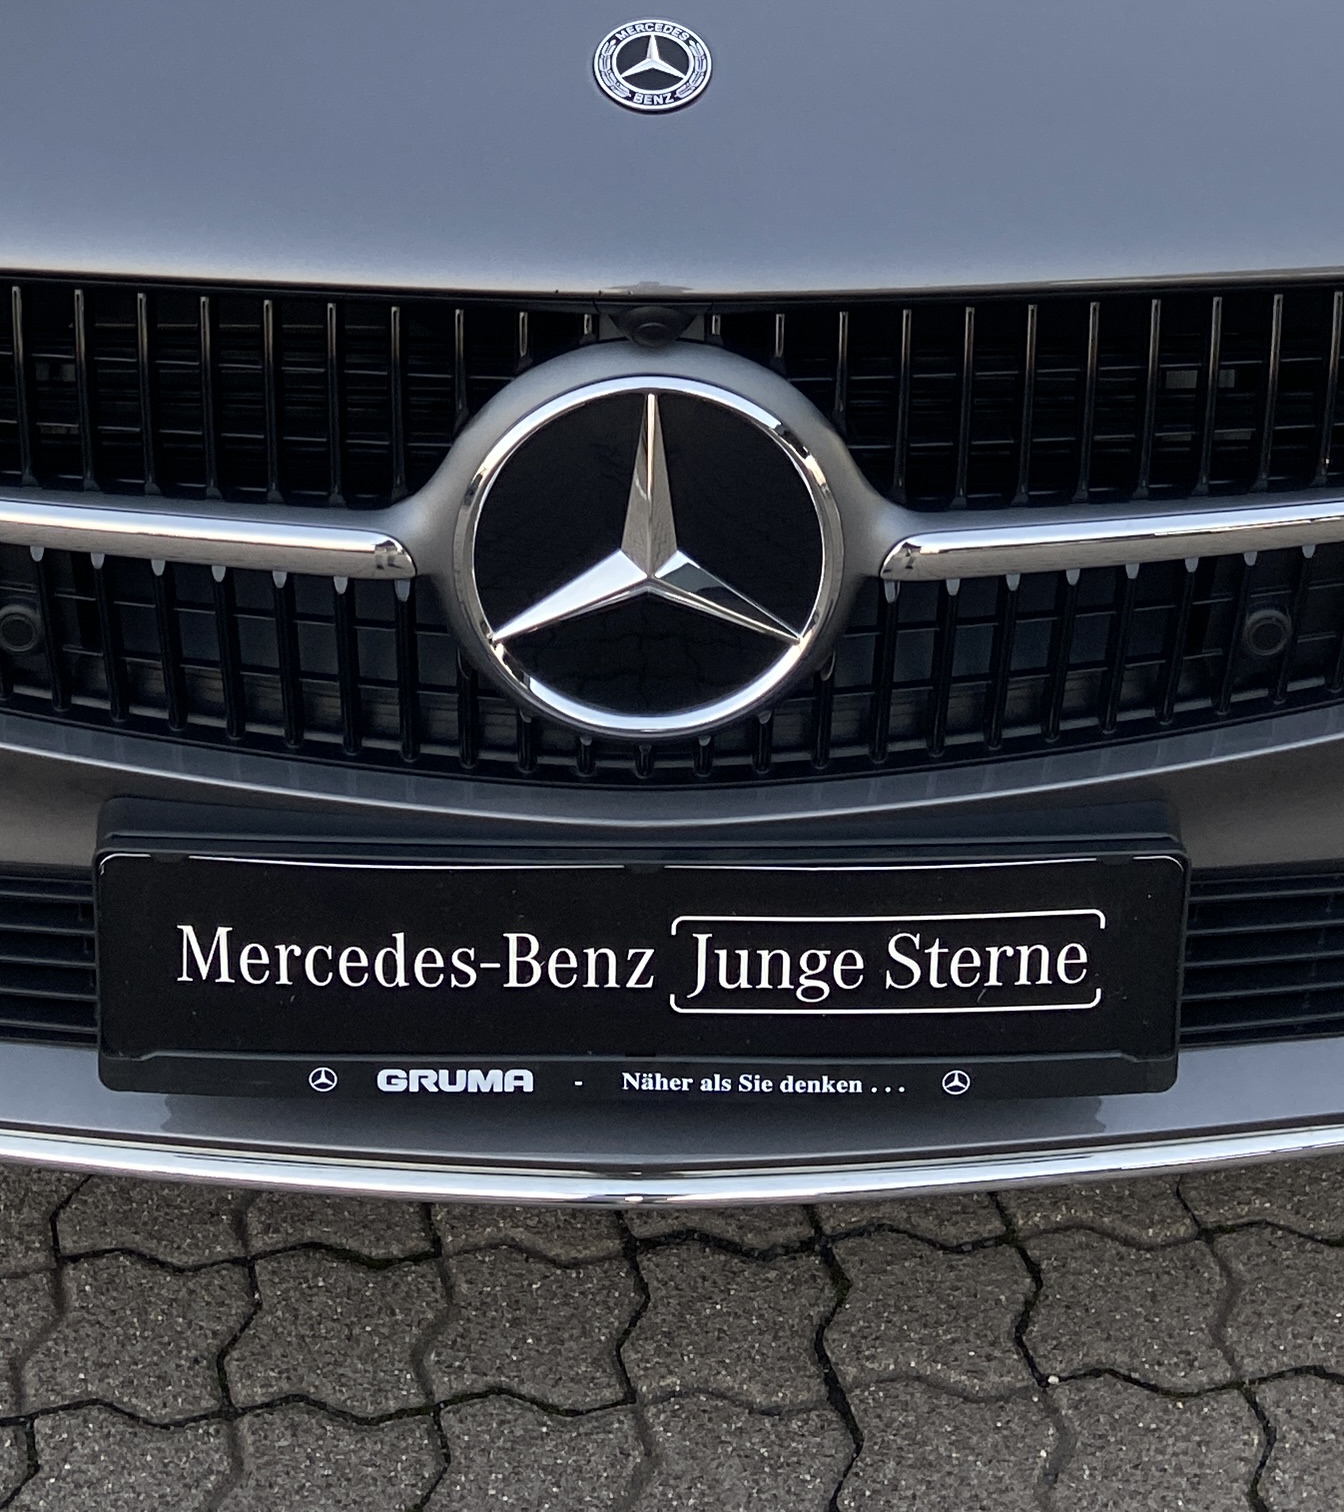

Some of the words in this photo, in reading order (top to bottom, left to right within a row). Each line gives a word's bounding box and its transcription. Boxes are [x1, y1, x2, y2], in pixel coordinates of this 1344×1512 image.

[614, 22, 690, 42] MERCEDES
[632, 92, 675, 105] BENZ
[175, 924, 655, 990] Mercedes-Benz
[686, 932, 865, 1004] Junge
[885, 931, 1089, 990] Sterne
[376, 1068, 535, 1093] GRUMA
[621, 1071, 693, 1092] Näher
[699, 1073, 732, 1093] als
[738, 1074, 773, 1093] Sie
[779, 1074, 863, 1094] denken
